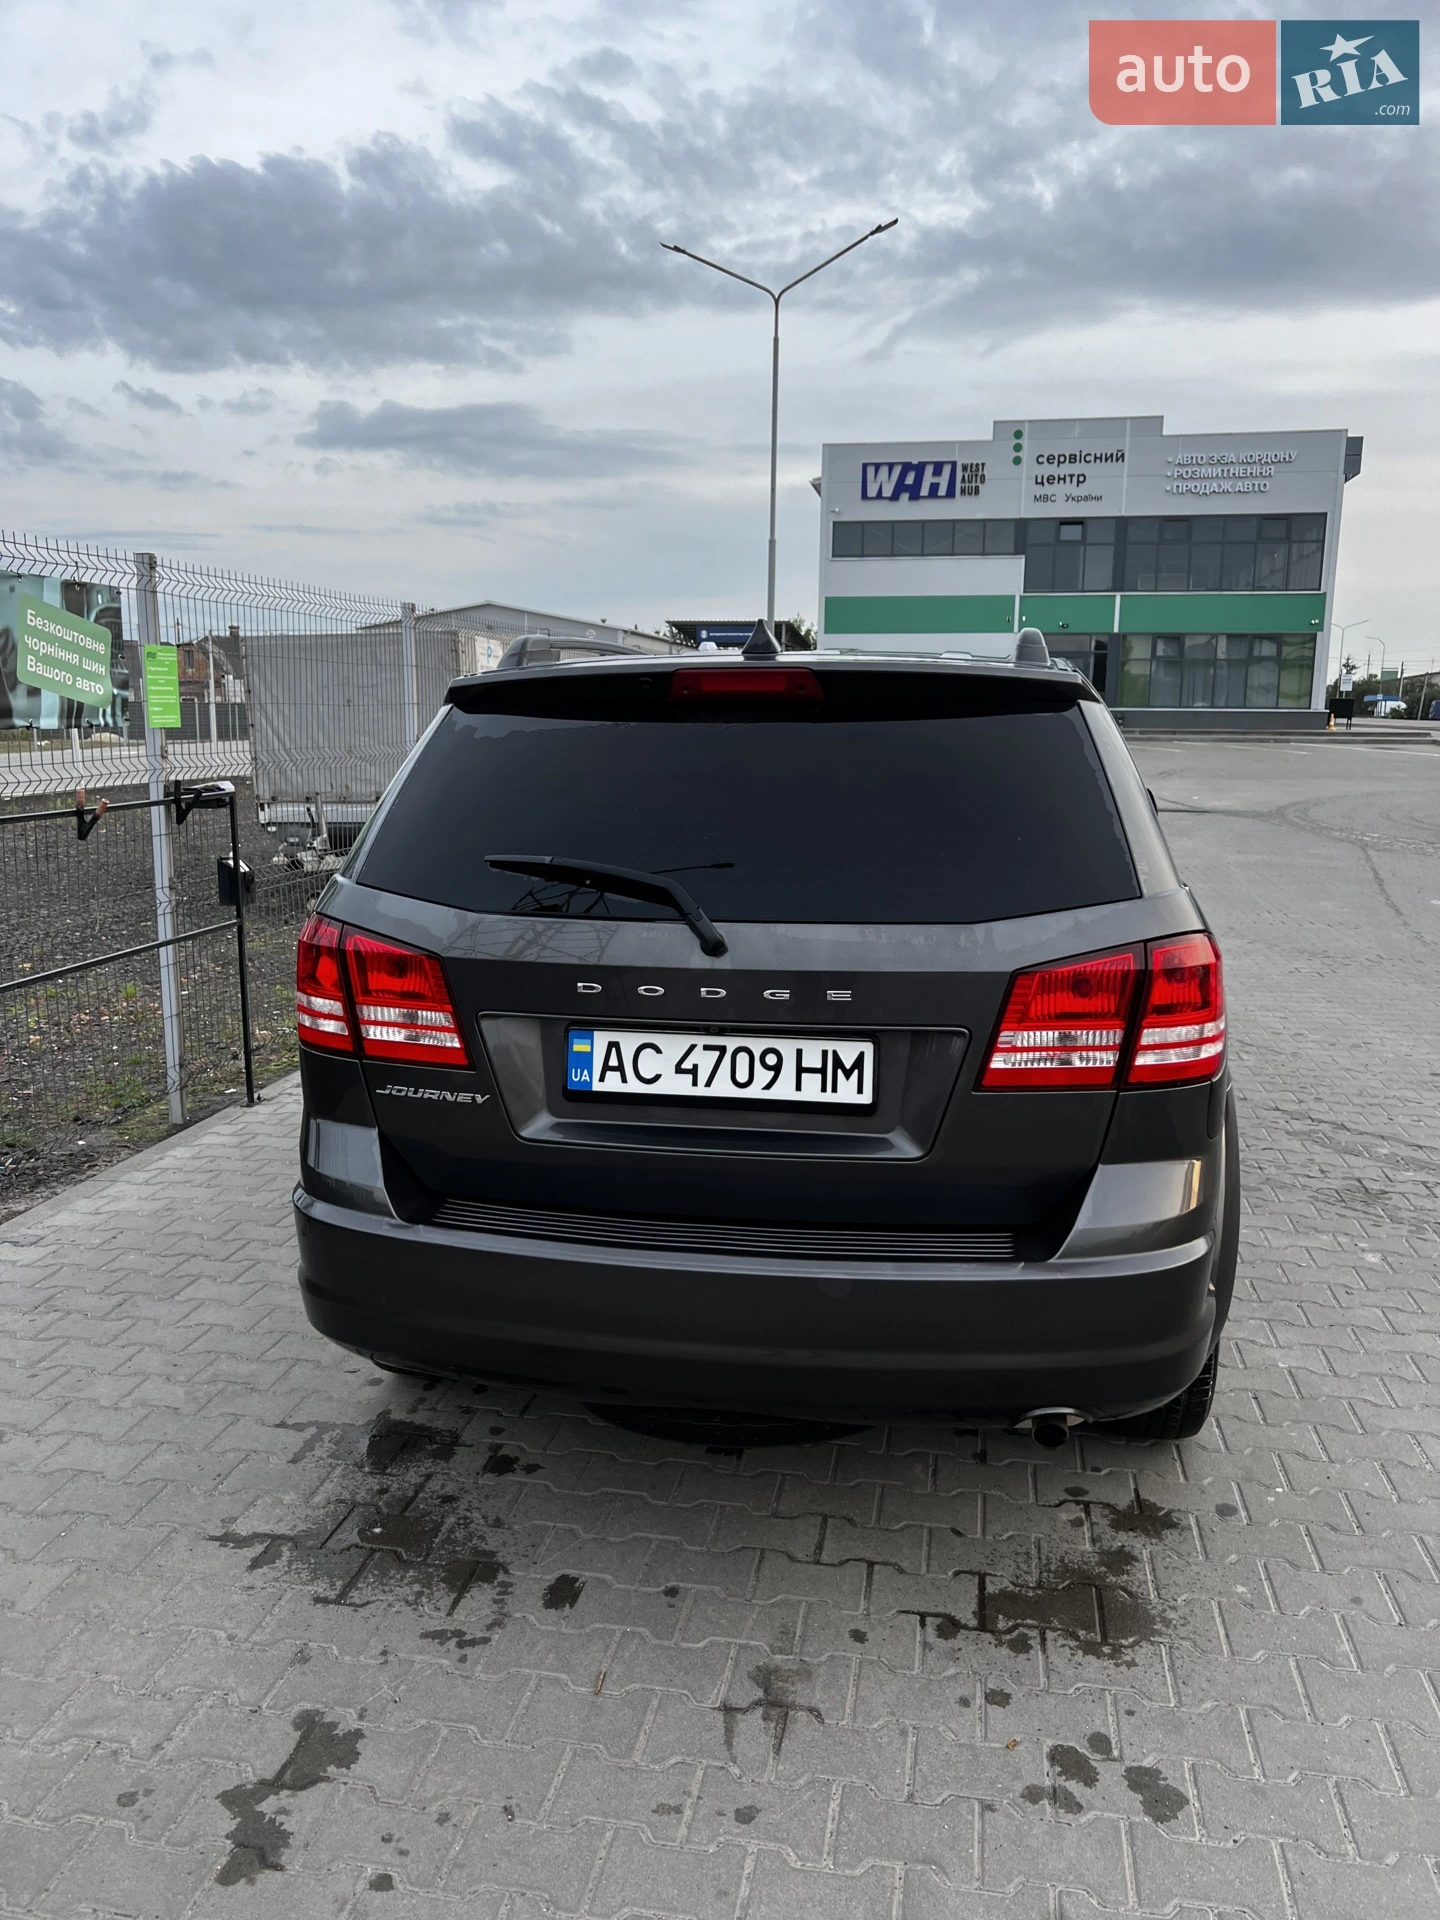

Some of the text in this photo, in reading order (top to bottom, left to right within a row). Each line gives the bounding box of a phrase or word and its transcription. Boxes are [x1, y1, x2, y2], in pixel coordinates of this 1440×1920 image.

[1036, 449, 1125, 468] сервісний
[1175, 454, 1206, 465] АВТО
[1239, 451, 1298, 465] КОРДОНУ
[961, 462, 986, 473] WEST
[1174, 466, 1275, 479] РОЗМИТНЕННЯ
[866, 461, 952, 500] WAH
[960, 474, 986, 484] AUTO
[1035, 473, 1087, 487] центр
[960, 485, 980, 496] HUB
[1172, 481, 1270, 496] ПРОДАЖ АВТО
[1033, 493, 1103, 503] МВС України
[26, 608, 106, 655] Безкоштовне
[24, 634, 106, 676] чорніння шин
[26, 654, 105, 696] Вашого авто
[577, 982, 852, 1001] DODGE
[571, 1068, 590, 1082] UA
[597, 1040, 865, 1095] AC 4709 HM
[375, 1084, 491, 1105] JOURNEY
